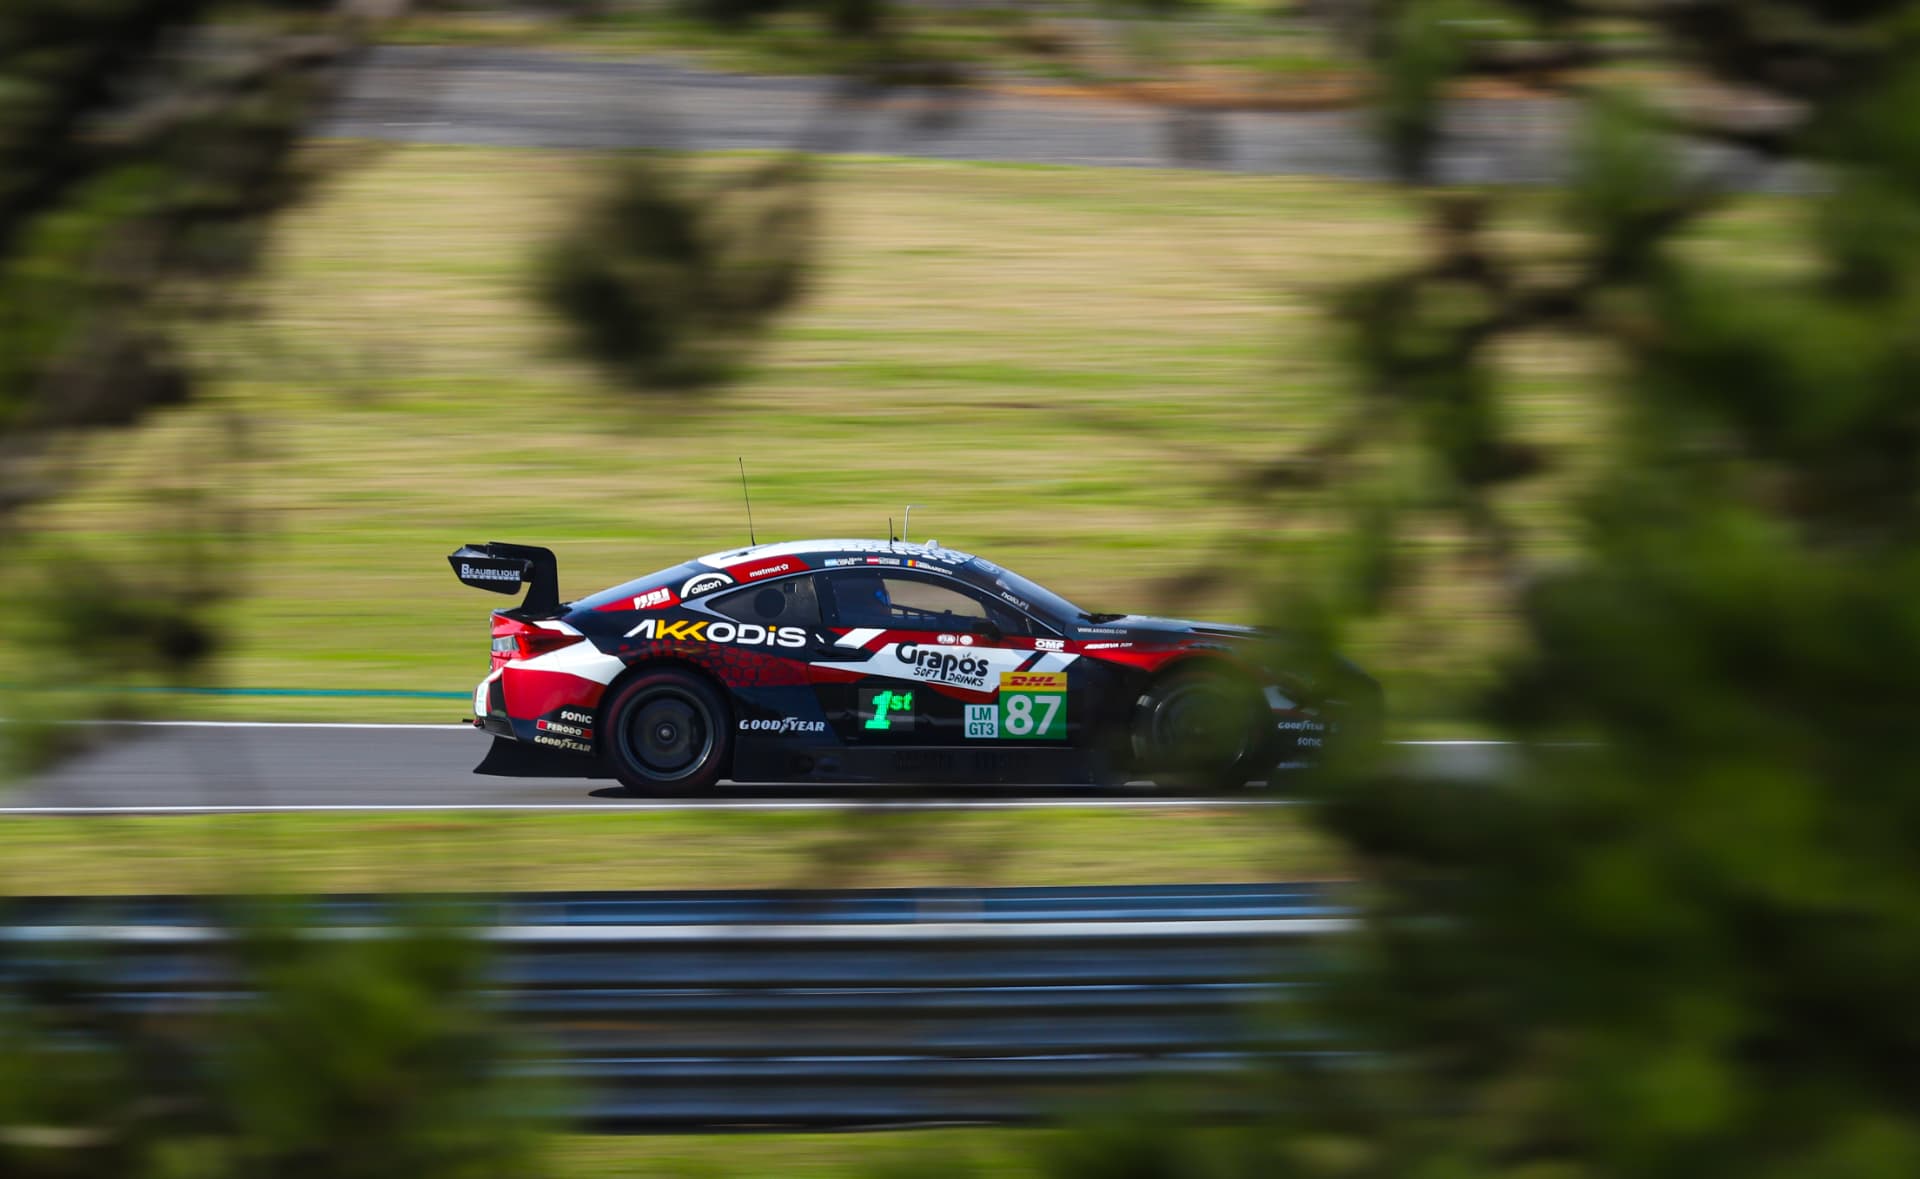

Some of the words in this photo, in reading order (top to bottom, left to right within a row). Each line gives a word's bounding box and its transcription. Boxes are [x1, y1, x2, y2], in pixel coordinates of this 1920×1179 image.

[461, 563, 520, 577] BEAUBELIQUE
[750, 567, 781, 578] matmut
[1035, 640, 1064, 649] OMP
[914, 667, 939, 678] SOFT
[947, 672, 984, 687] DRINKS
[1010, 676, 1056, 686] DHL
[865, 690, 912, 729] 1st
[972, 707, 992, 720] LM
[1005, 694, 1062, 735] 87
[547, 722, 582, 735] FERODO
[739, 717, 825, 733] GOODYEAR
[969, 722, 994, 736] GT3
[534, 735, 591, 752] GOODYEAR
